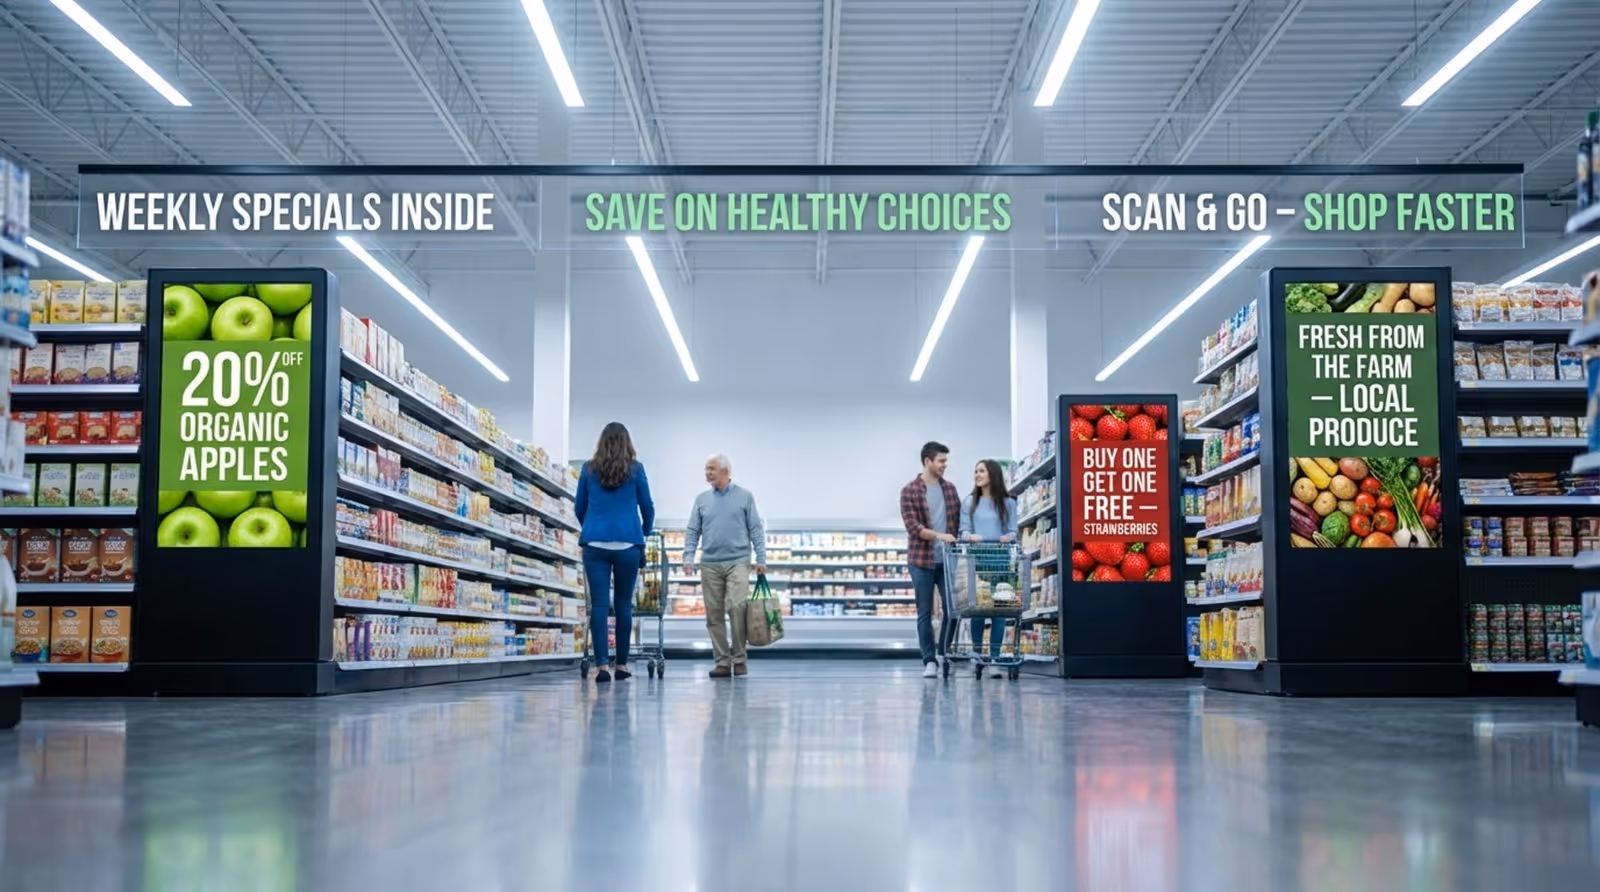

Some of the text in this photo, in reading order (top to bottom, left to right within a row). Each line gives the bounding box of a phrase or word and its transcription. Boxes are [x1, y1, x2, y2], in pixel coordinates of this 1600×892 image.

[97, 192, 494, 231] WEEKLY SPECIALS INSIDE
[585, 192, 1012, 231] SAVE ON HEALTHY CHOICES
[1102, 192, 1186, 231] SCAN
[1196, 193, 1217, 231] &
[1226, 192, 1268, 231] GO
[1303, 192, 1388, 231] SHOP
[1397, 192, 1515, 231] FASTER
[1298, 324, 1424, 349] FRESH FROM
[181, 350, 304, 408] 20% OFF
[1311, 354, 1412, 379] THE FARM
[1340, 383, 1415, 413] LOCAL
[180, 411, 289, 442] ORGANIC
[1309, 417, 1418, 447] PRODUCE
[179, 446, 288, 481] APPLES
[1083, 447, 1157, 469] BUY ONE
[1083, 471, 1157, 493] GET ONE
[1083, 495, 1135, 520] FREE
